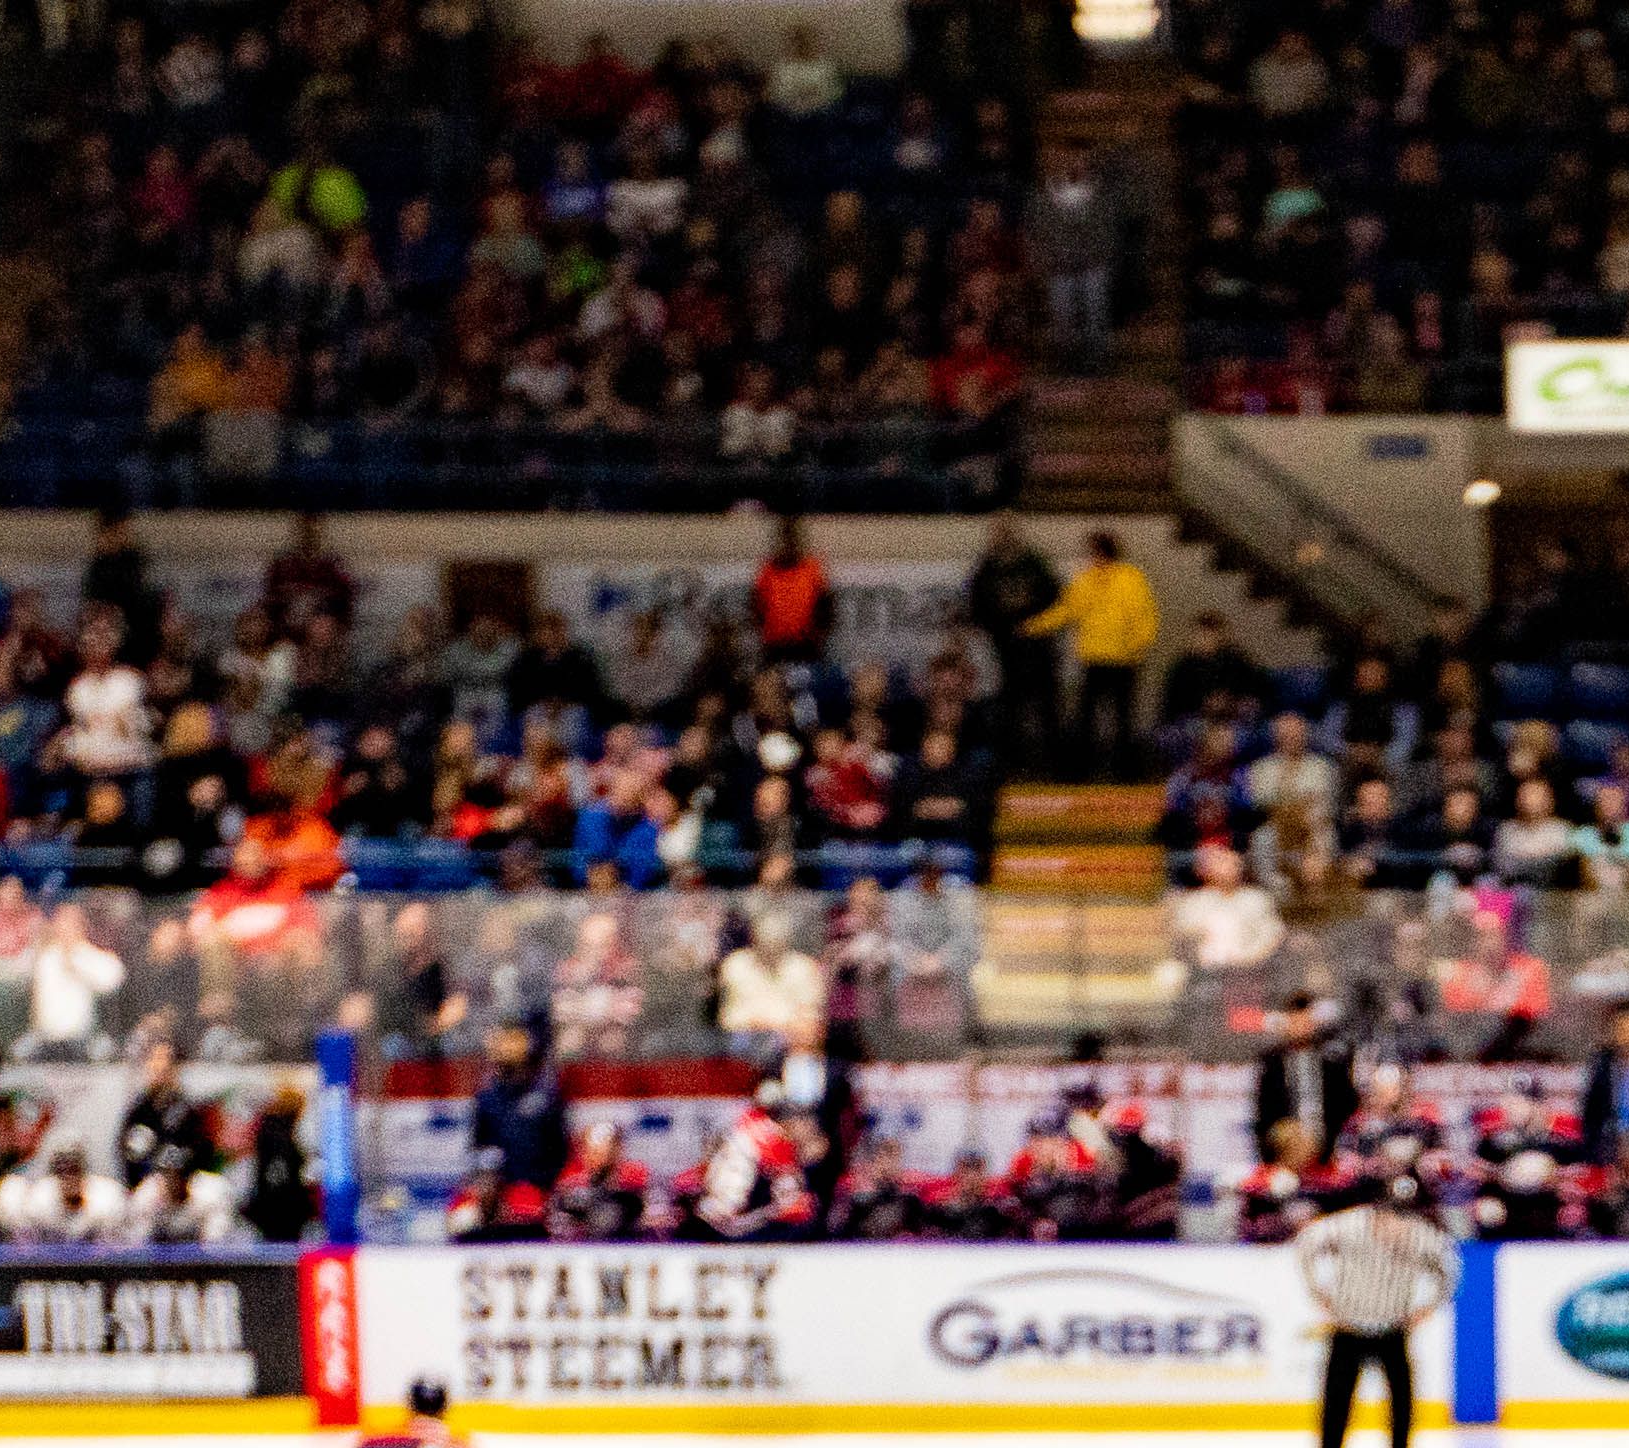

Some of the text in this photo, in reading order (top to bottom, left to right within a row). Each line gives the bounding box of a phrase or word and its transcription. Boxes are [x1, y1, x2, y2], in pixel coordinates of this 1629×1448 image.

[461, 1261, 780, 1321] STANLEY
[464, 1333, 784, 1396] STEEMER
[929, 1298, 1265, 1368] GARBER
